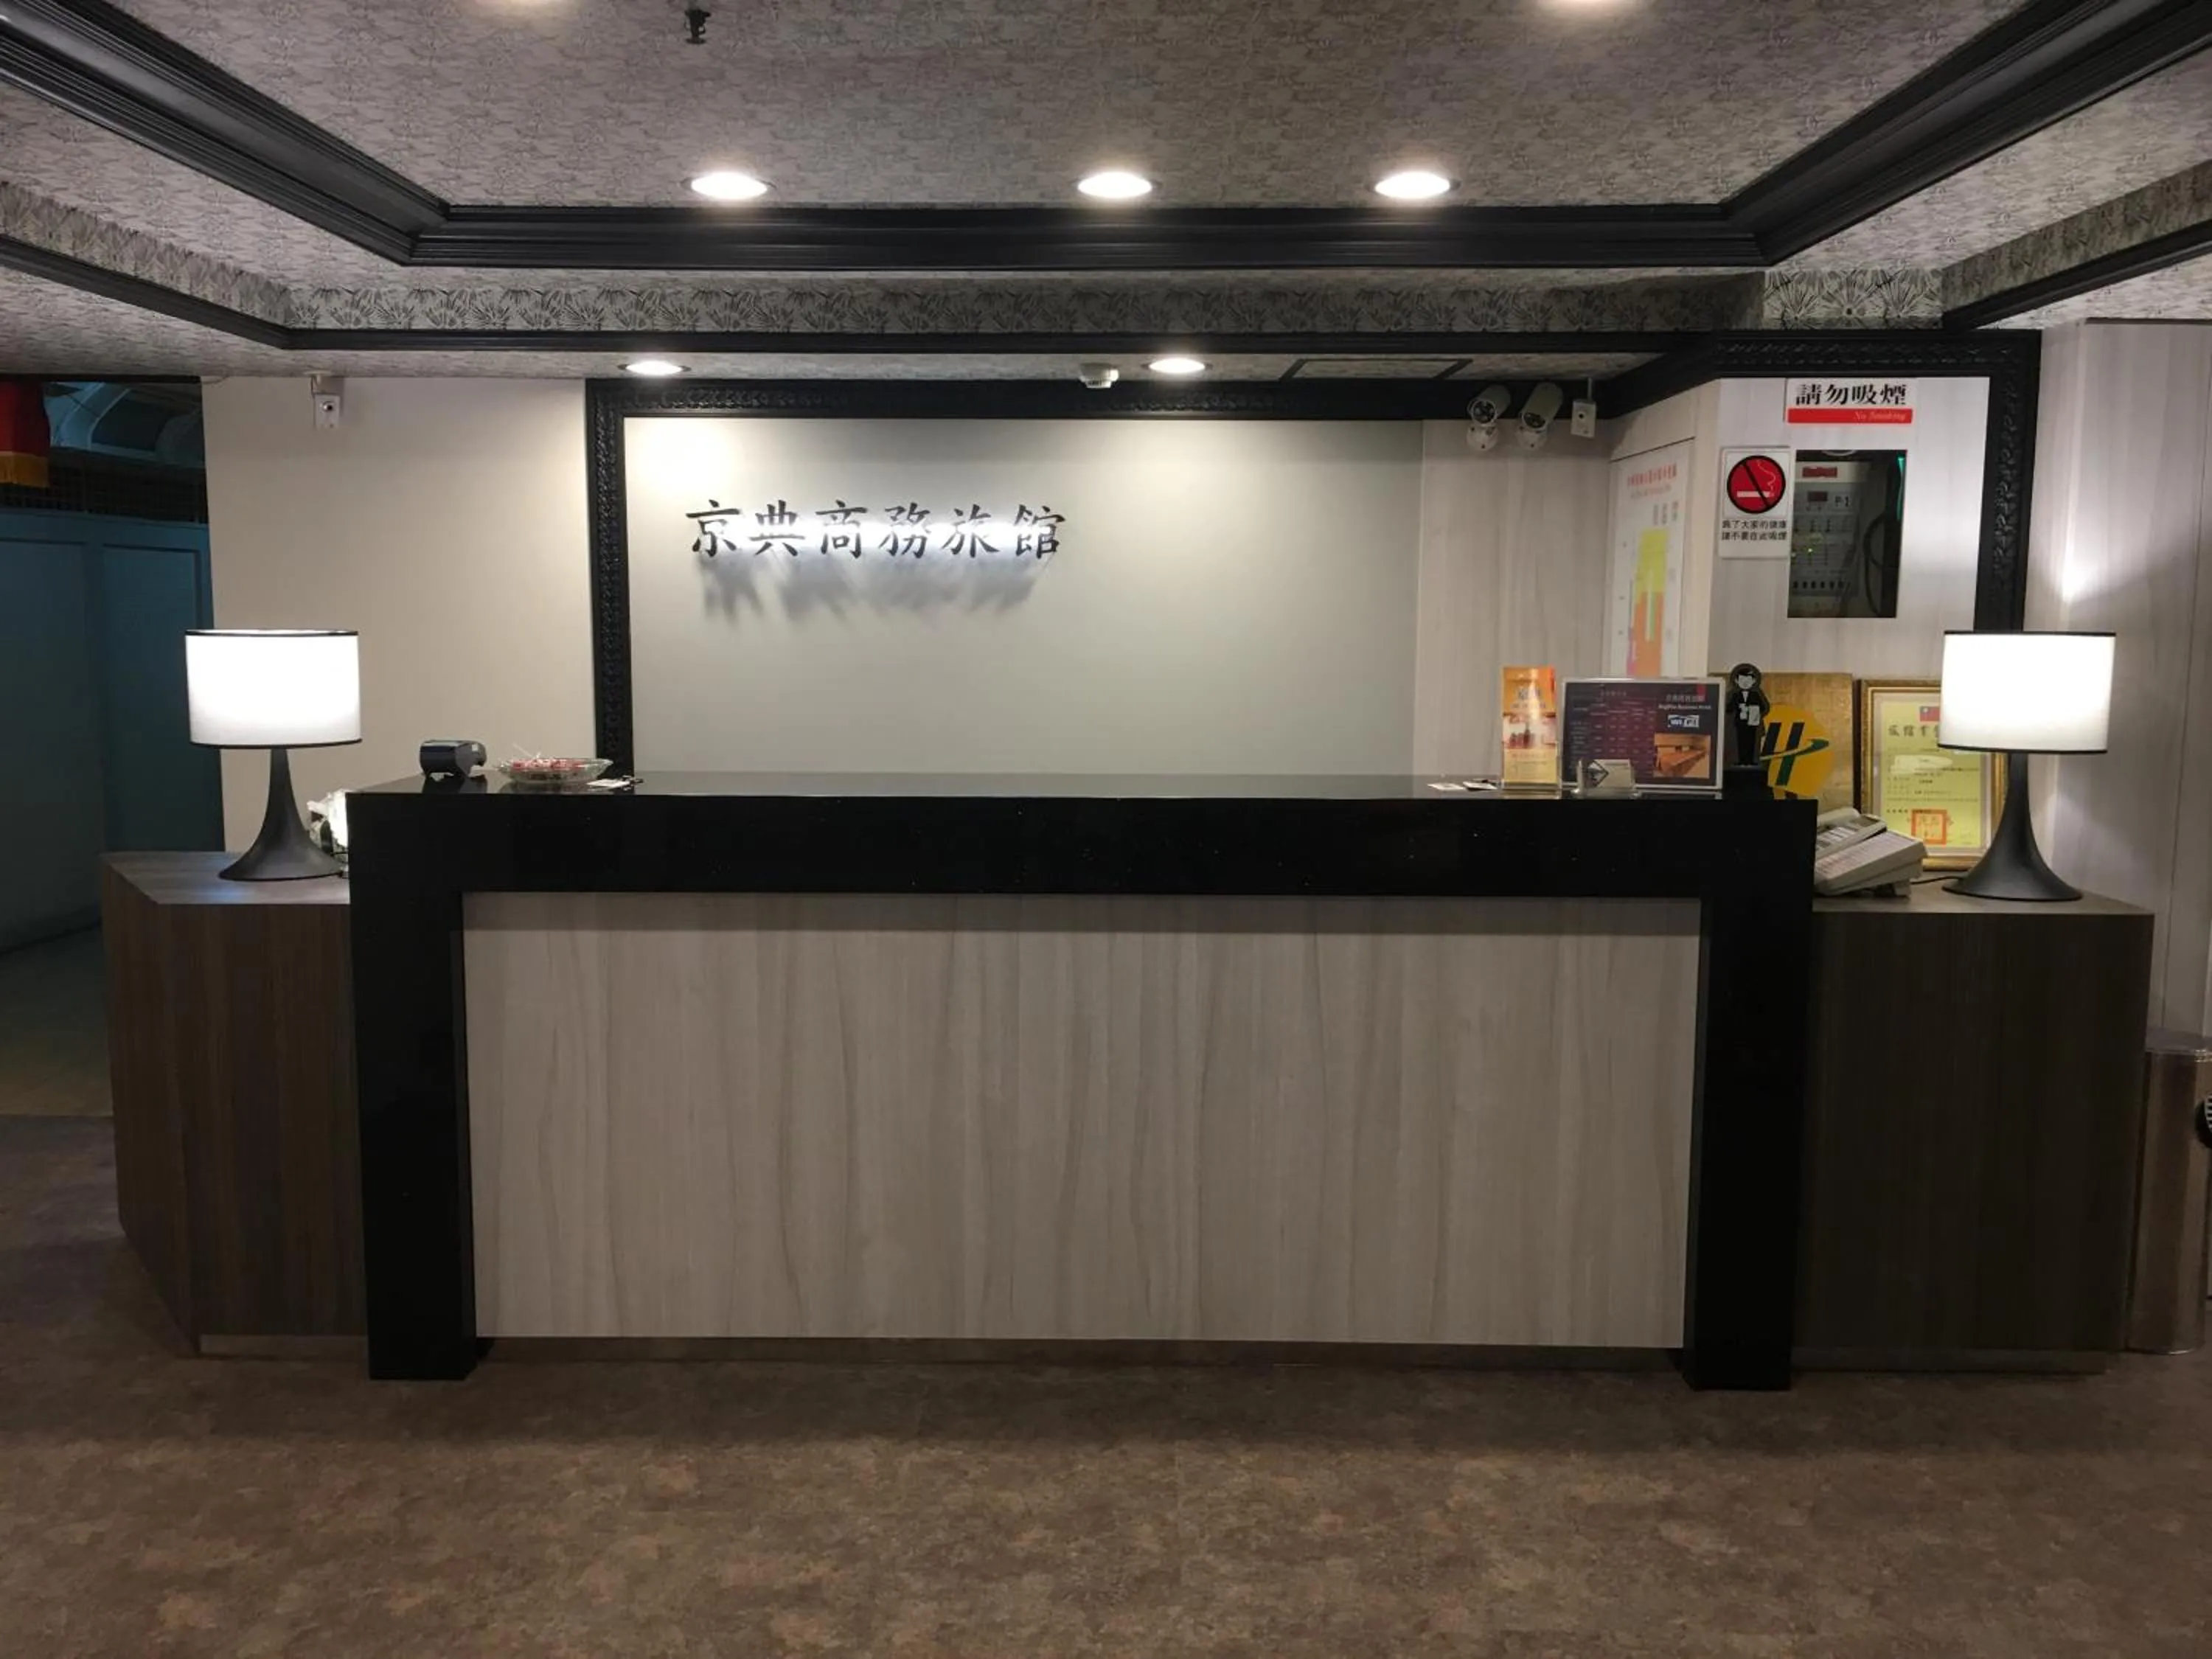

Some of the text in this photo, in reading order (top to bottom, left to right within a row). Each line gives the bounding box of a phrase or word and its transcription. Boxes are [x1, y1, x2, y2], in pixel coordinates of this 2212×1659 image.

[1795, 384, 1907, 405] 請勿吸煙
[686, 499, 1066, 559] 京典商務旅館
